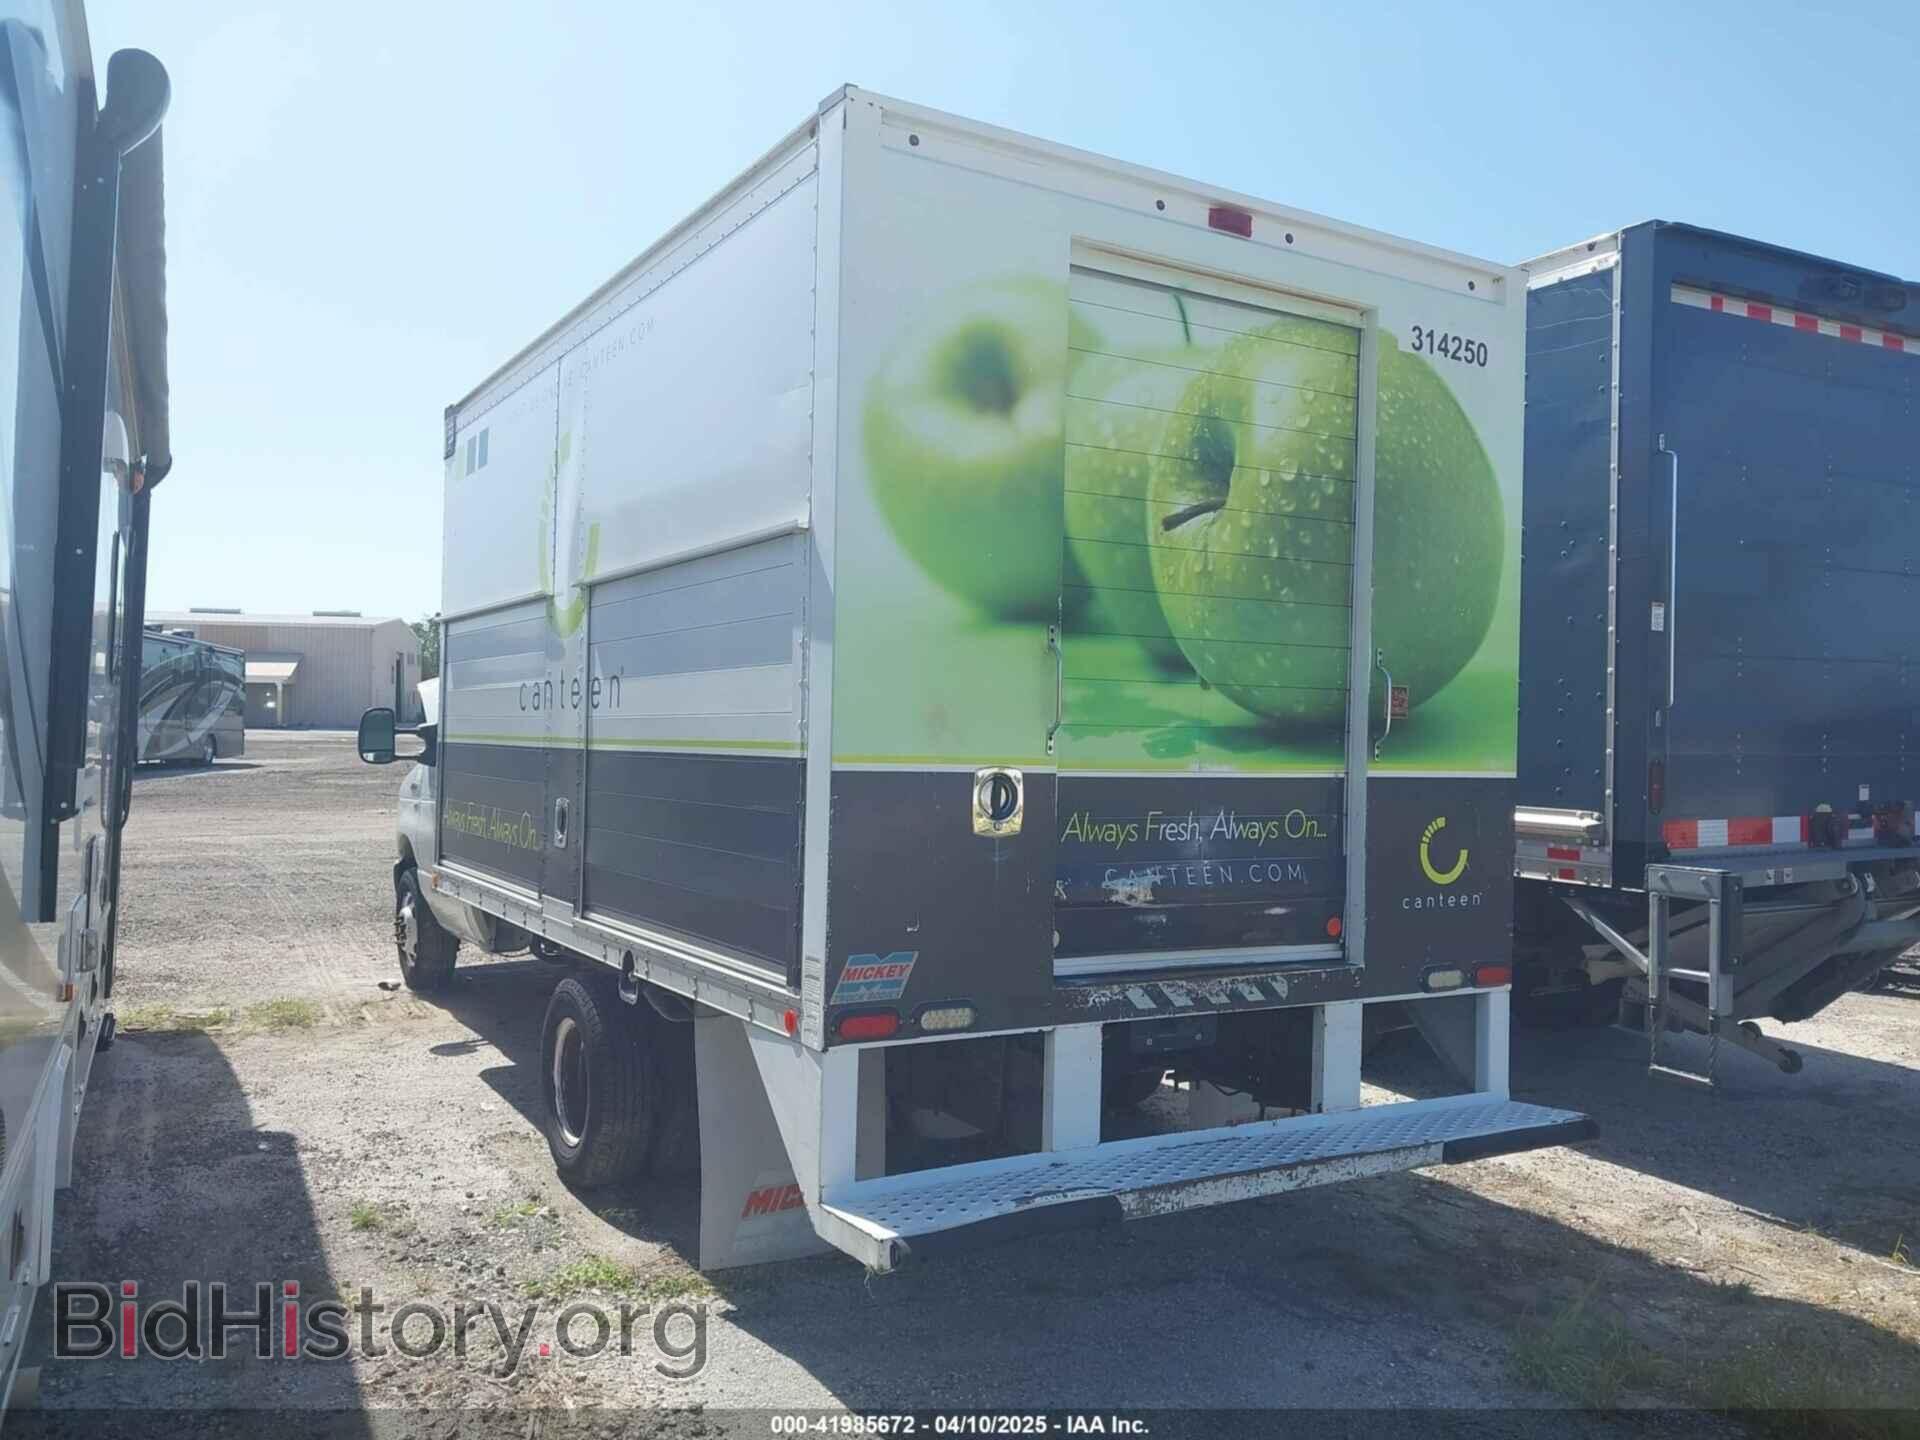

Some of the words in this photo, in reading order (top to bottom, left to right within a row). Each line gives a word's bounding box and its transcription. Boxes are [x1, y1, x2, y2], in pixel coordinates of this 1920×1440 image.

[1411, 325, 1488, 367] 314250
[519, 668, 622, 711] canteen
[1060, 811, 1138, 850] Always
[1145, 810, 1203, 843] Fresh,
[1210, 808, 1279, 847] Always
[1285, 809, 1327, 839] On...
[1403, 893, 1481, 909] canteen
[842, 963, 912, 982] MICKEY
